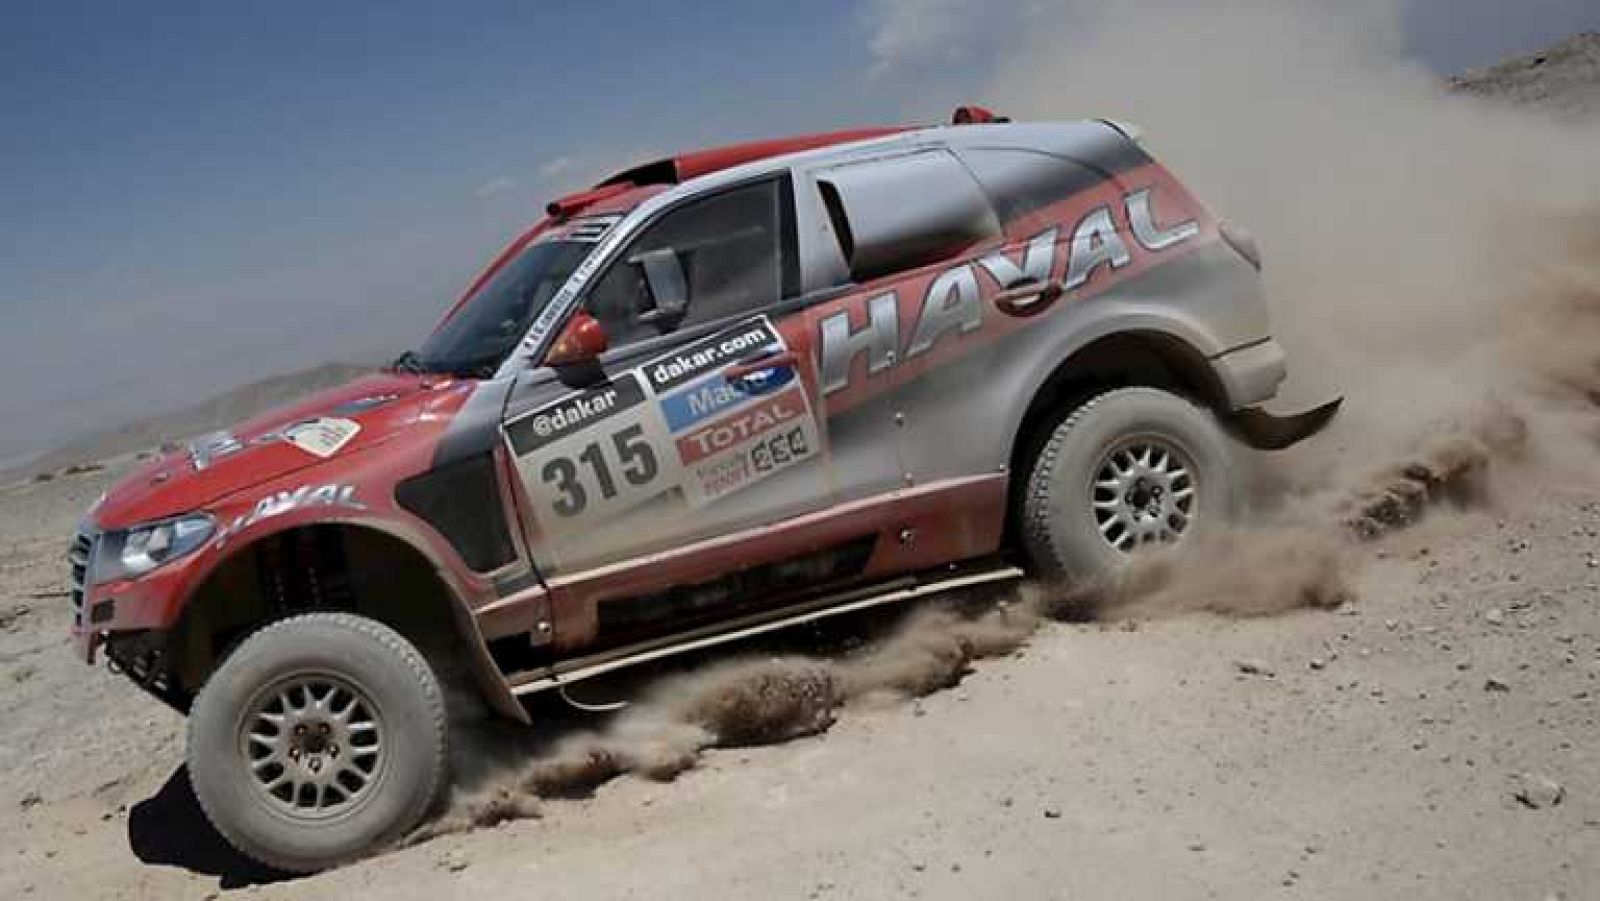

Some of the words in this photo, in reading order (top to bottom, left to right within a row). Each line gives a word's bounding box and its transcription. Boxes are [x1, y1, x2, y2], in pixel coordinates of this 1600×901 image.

[819, 189, 1199, 395] HAVAL
[653, 328, 766, 383] dakar.com
[533, 388, 617, 437] @dakar
[696, 403, 789, 453] TOTAL
[541, 424, 658, 517] 315
